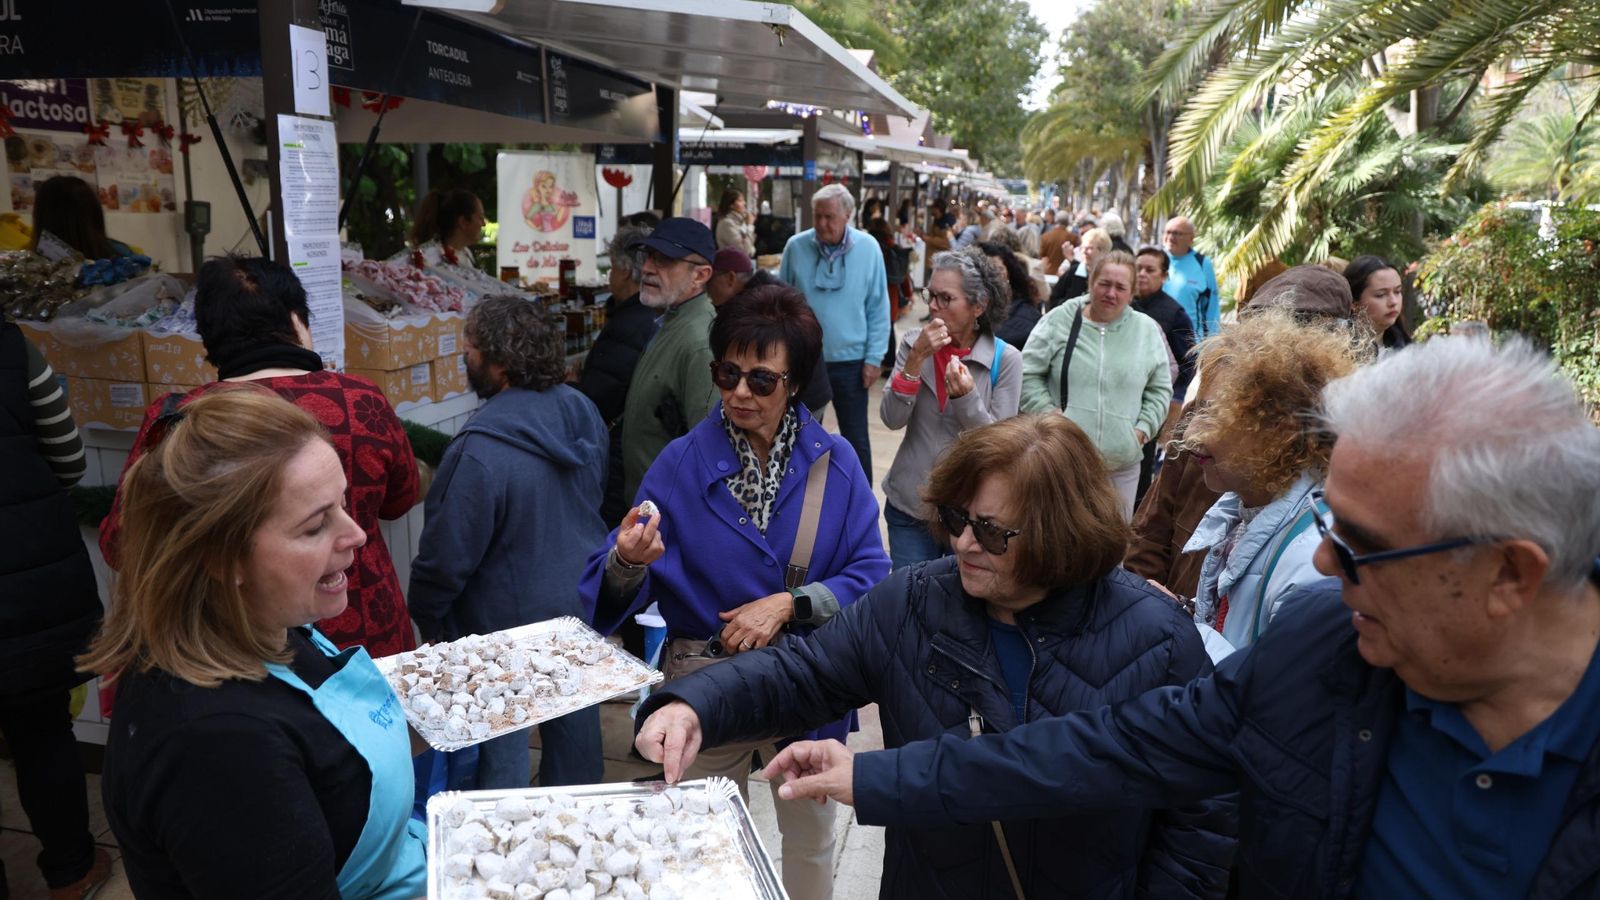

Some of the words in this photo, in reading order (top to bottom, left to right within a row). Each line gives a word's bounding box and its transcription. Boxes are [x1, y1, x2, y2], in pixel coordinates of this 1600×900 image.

[326, 43, 350, 65] aga
[295, 49, 321, 90] 13
[428, 65, 472, 88] ANTEQUERA
